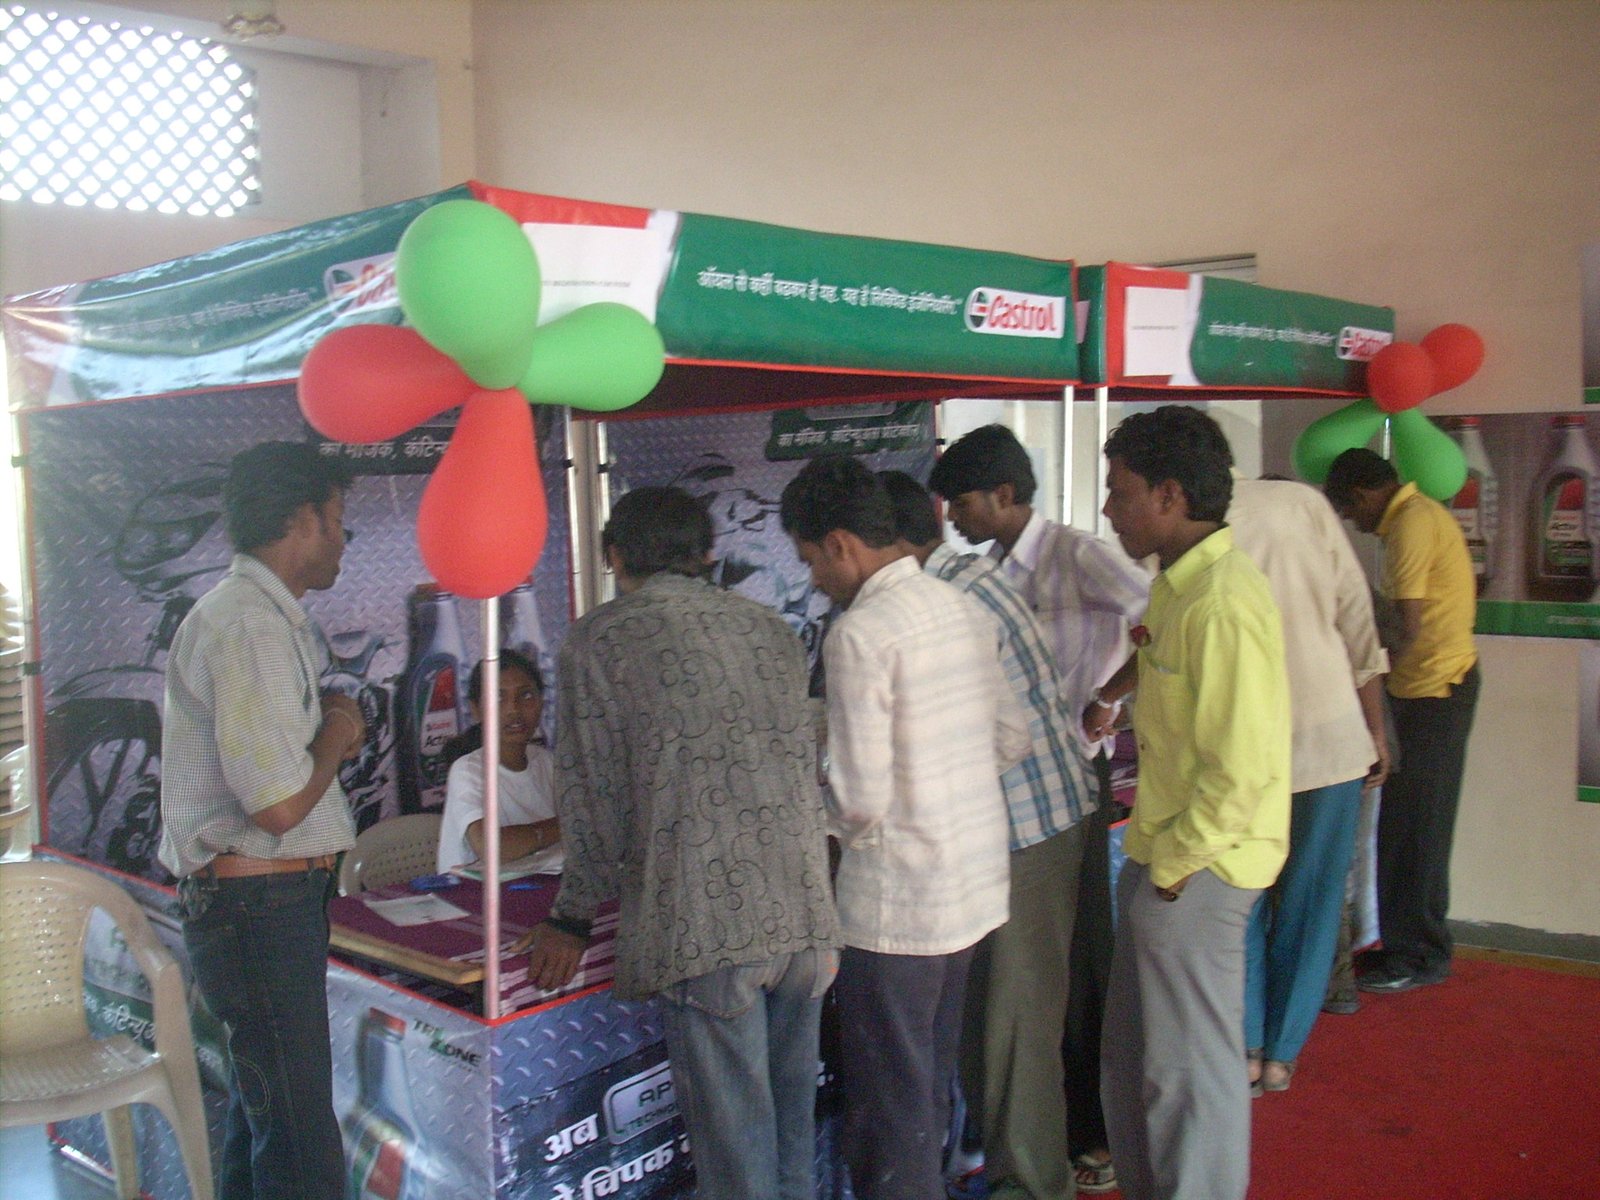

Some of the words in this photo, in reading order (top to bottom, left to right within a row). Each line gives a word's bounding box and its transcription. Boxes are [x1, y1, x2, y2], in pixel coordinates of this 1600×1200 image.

[989, 294, 1056, 332] Castrol
[639, 1080, 673, 1107] AP
[544, 1113, 599, 1162] अब
